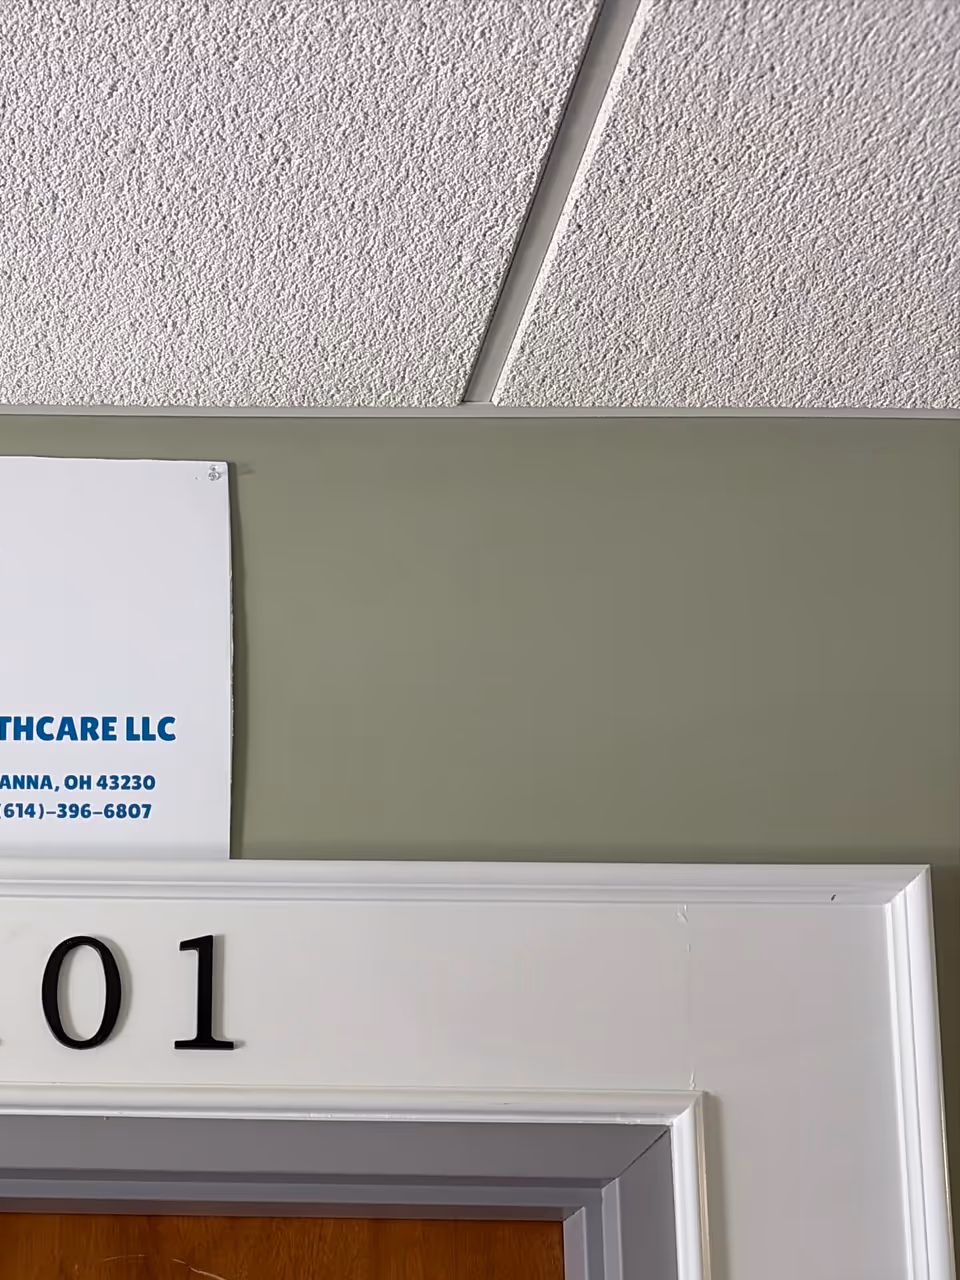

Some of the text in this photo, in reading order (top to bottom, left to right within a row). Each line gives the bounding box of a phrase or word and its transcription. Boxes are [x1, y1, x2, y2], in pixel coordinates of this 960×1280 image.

[125, 716, 177, 742] LLC
[64, 774, 91, 790] OH
[96, 774, 156, 790] 43230
